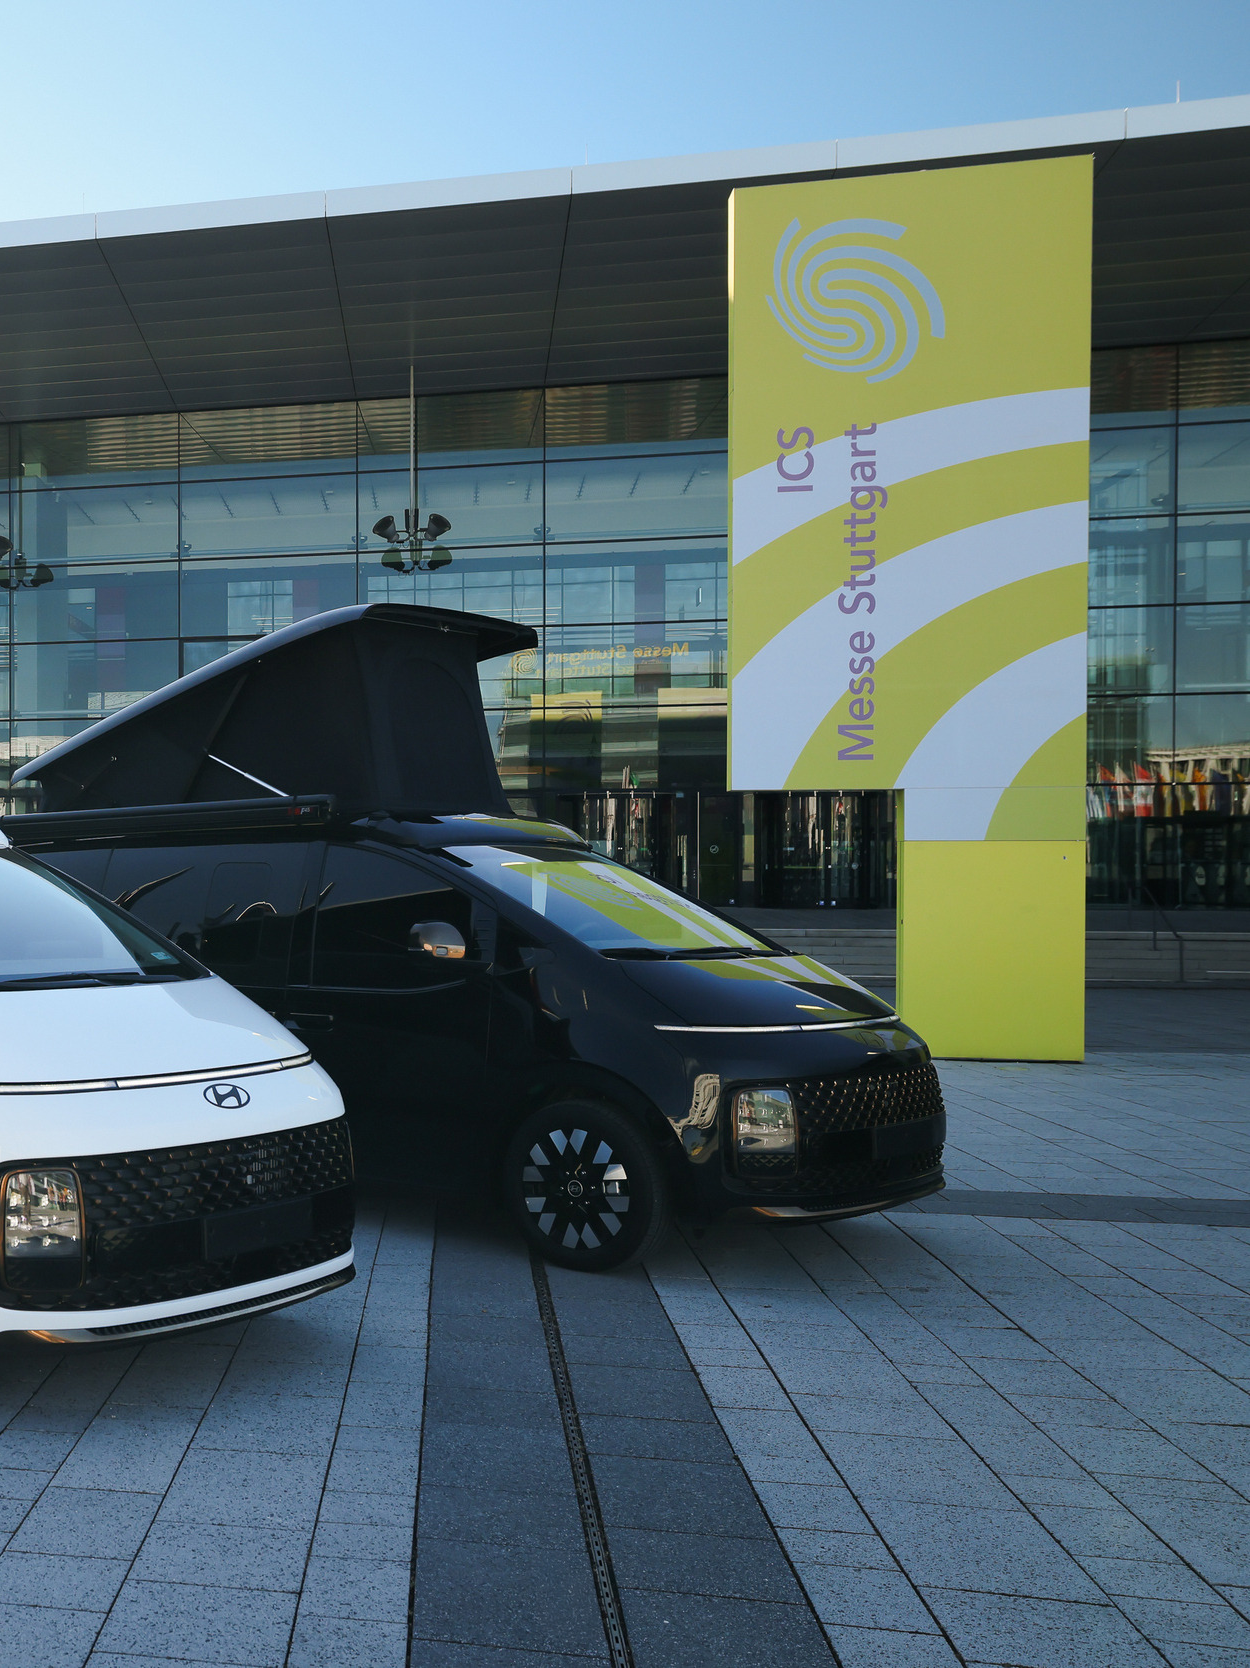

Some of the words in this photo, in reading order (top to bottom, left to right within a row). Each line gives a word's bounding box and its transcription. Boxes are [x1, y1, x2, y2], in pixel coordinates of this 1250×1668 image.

[776, 425, 814, 493] ICS
[837, 422, 889, 615] Stuttgart
[837, 630, 876, 762] Messe
